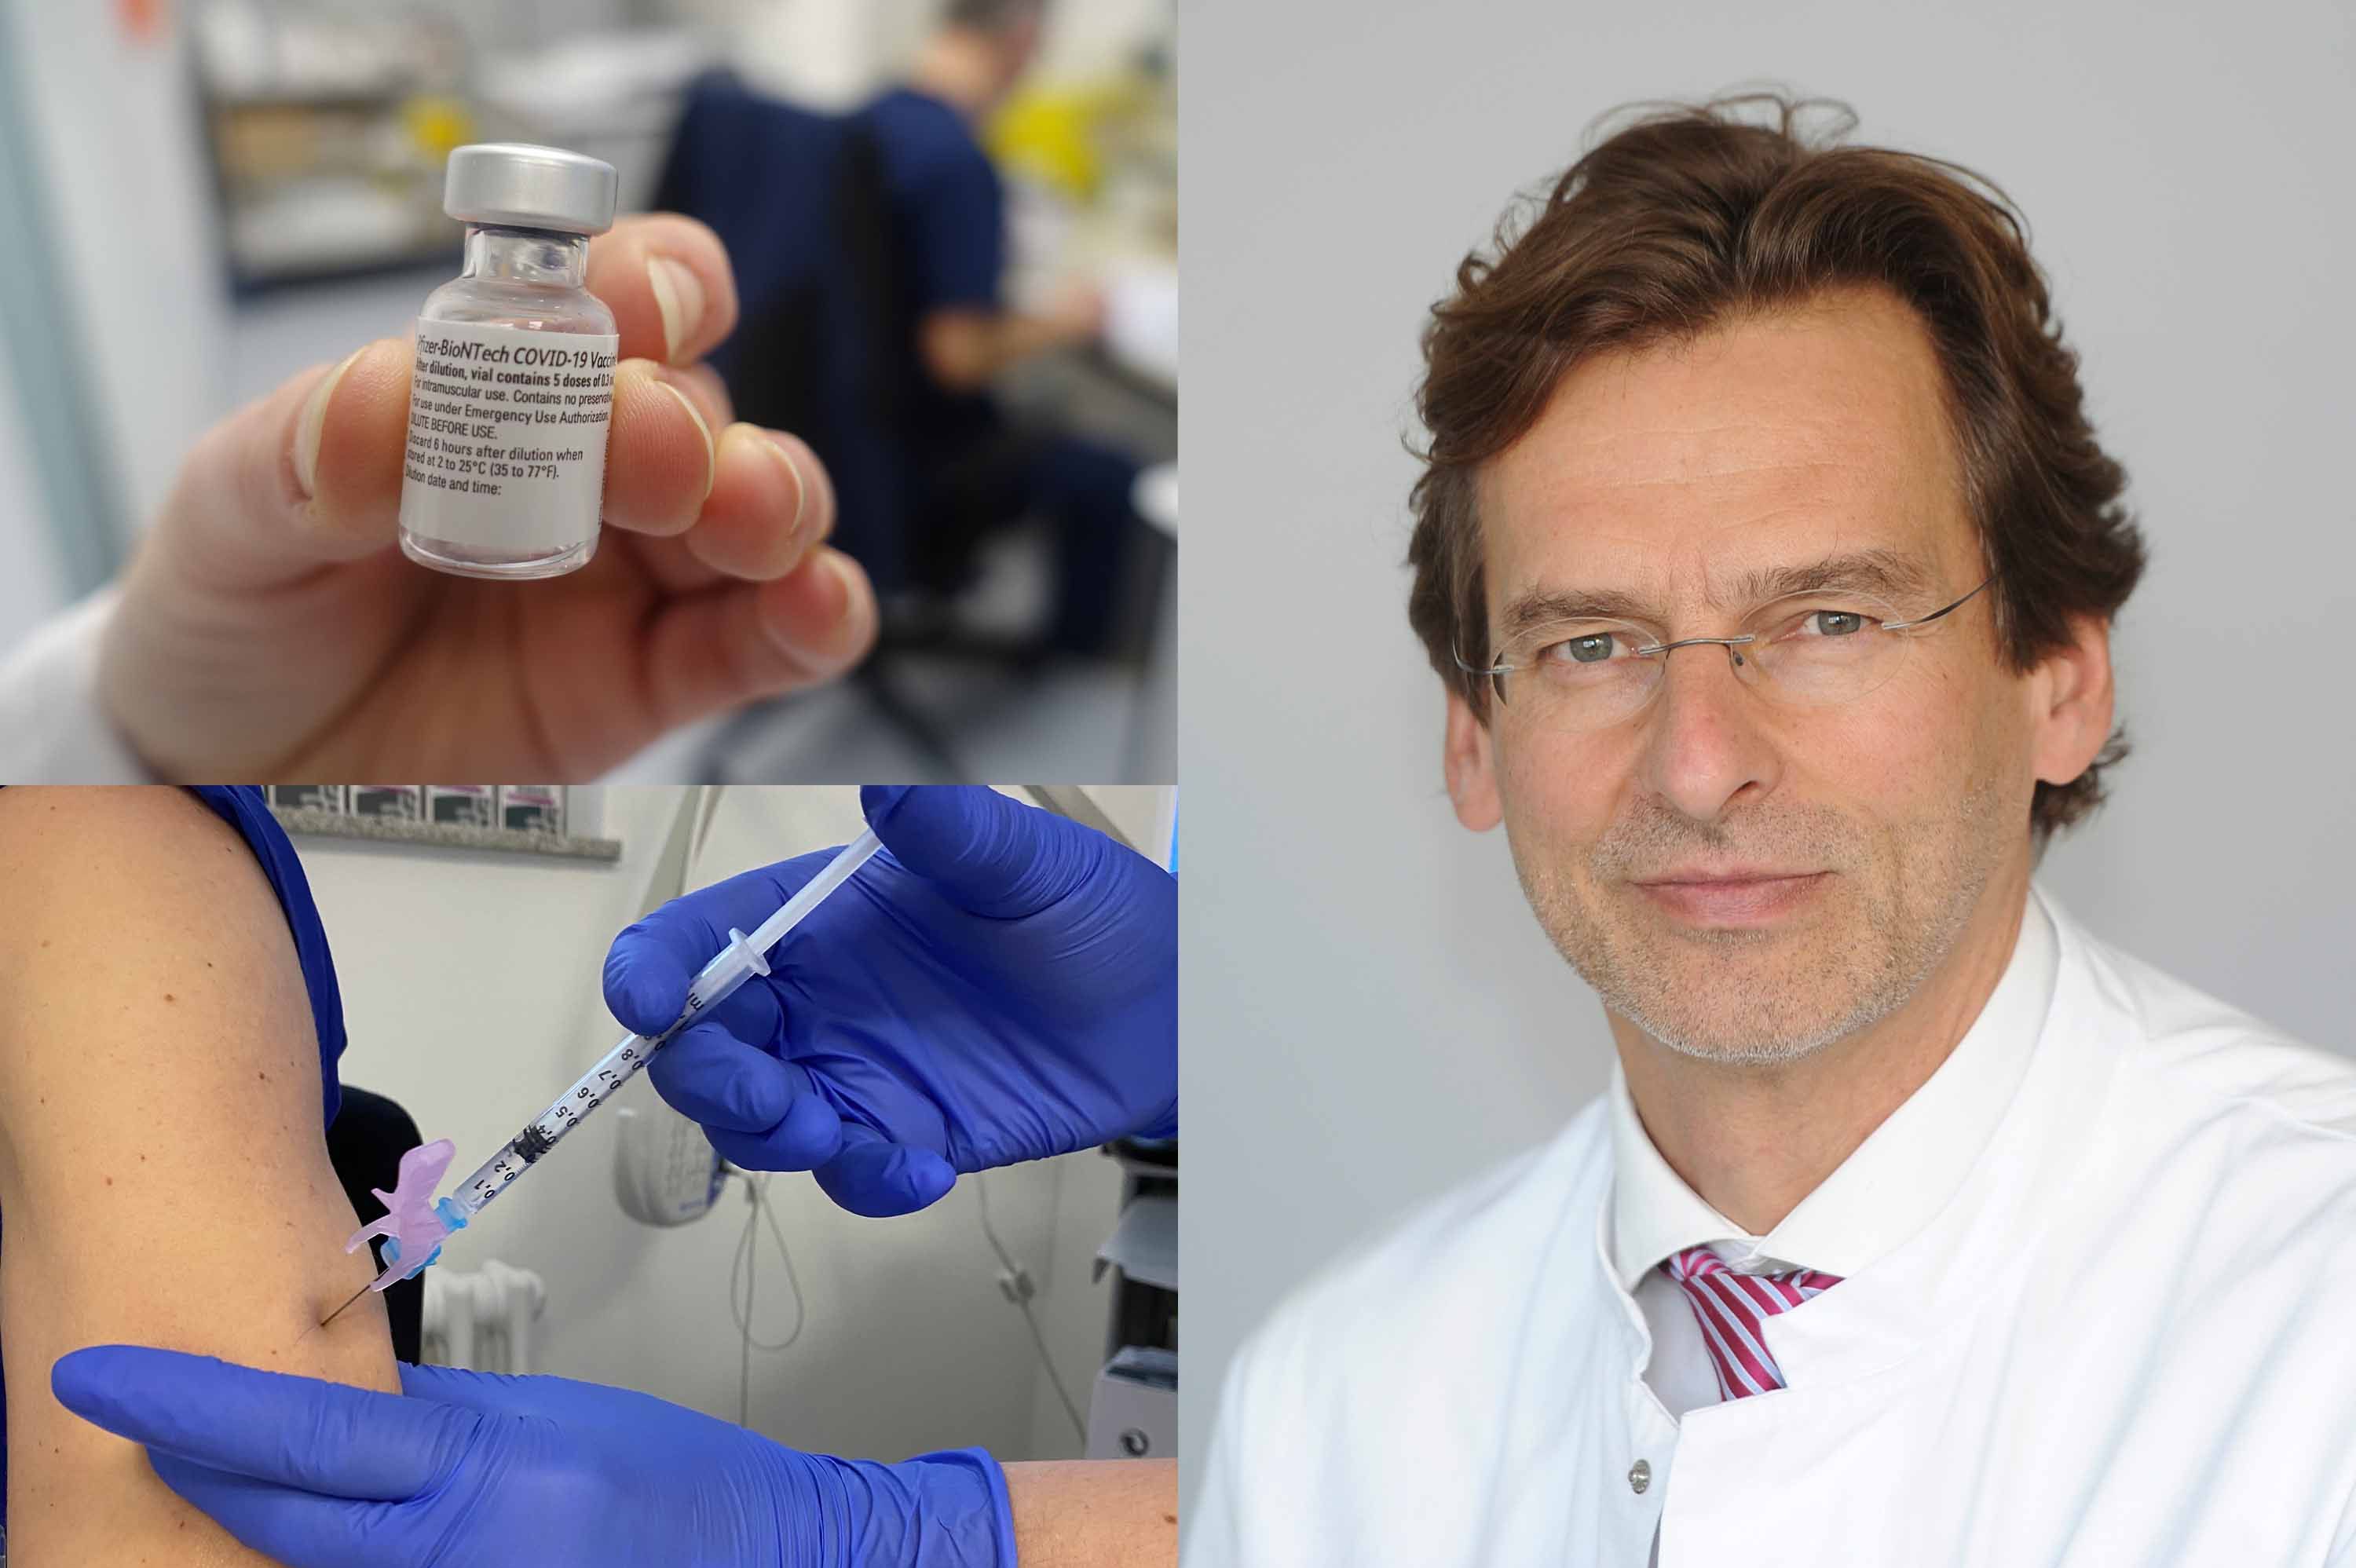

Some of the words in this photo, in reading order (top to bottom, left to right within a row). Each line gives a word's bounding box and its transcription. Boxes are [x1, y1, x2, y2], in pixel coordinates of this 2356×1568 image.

[514, 347, 587, 368] COVID-19
[591, 351, 616, 368] Vaccin
[430, 360, 468, 381] dilution,
[471, 366, 494, 382] vial
[497, 371, 551, 386] contains
[554, 373, 561, 387] 5
[563, 373, 591, 387] doses
[593, 373, 601, 387] of
[422, 378, 483, 399] intramuscular
[485, 389, 510, 402] use.
[514, 389, 562, 405] Contains
[565, 394, 576, 405] no
[421, 399, 433, 411] use
[434, 401, 463, 415] under
[465, 404, 532, 425] Emergency
[535, 410, 557, 423] Use
[430, 417, 469, 437] BEFORE
[471, 423, 498, 440] USE.
[434, 437, 440, 451] 6
[441, 439, 473, 456] hours
[476, 444, 506, 459] after
[509, 447, 553, 461] dilution
[556, 448, 584, 462] when
[426, 455, 435, 466] at
[437, 455, 444, 468] 2
[445, 459, 455, 470] to
[459, 459, 486, 475] 25°C
[490, 462, 508, 477] (35
[511, 465, 524, 477] to
[527, 465, 560, 480] 77°F).
[427, 473, 447, 488] date
[448, 477, 469, 492] and
[472, 481, 502, 495] time:
[621, 1048, 644, 1070] 0,8
[598, 1070, 621, 1090] 0,7
[577, 1087, 599, 1109] 0,6
[555, 1106, 578, 1128] 0,5
[494, 1160, 515, 1182] 0,2
[474, 1179, 496, 1199] 0,1
